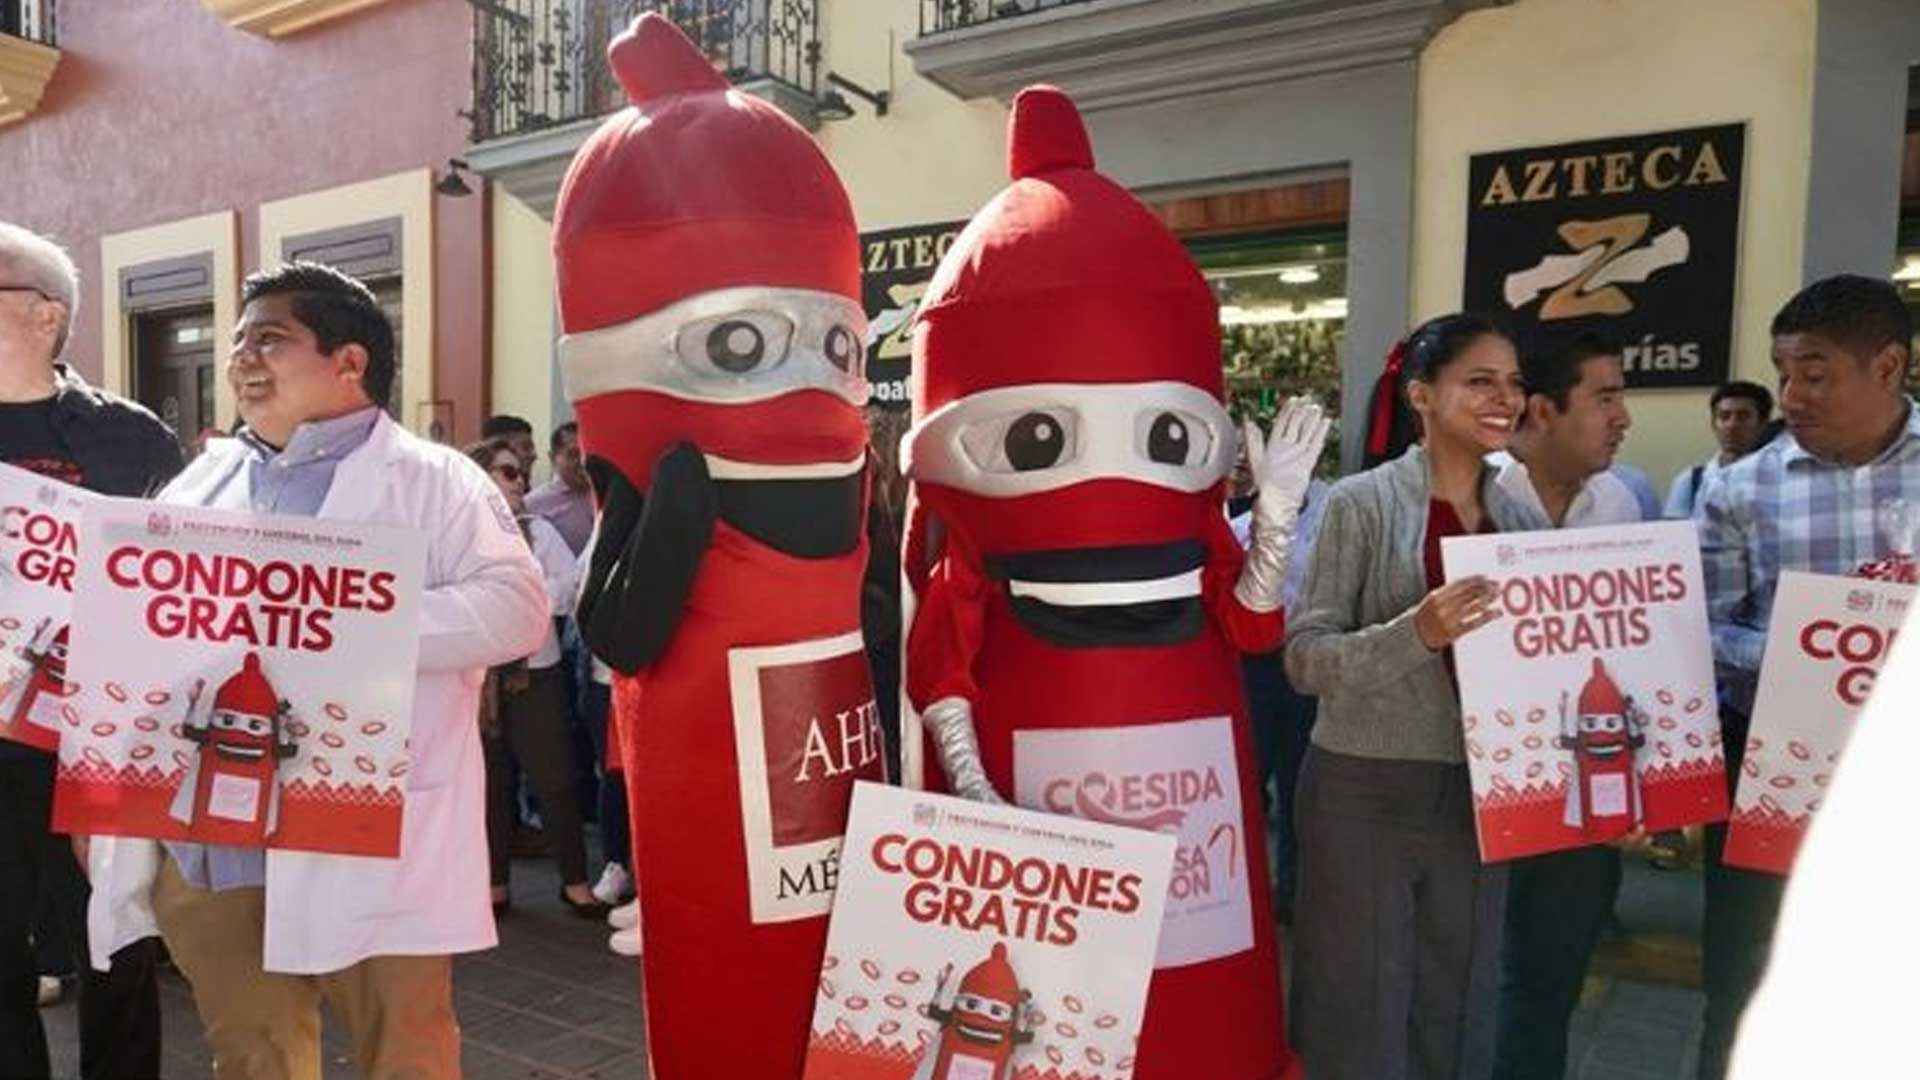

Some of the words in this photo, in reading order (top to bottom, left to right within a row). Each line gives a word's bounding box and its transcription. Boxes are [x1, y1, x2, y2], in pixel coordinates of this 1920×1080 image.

[1482, 141, 1727, 206] AZTECA
[1623, 333, 1700, 372] rías
[17, 549, 76, 593] GR
[106, 546, 397, 613] CONDONES
[1501, 563, 1687, 616] ONDONES
[146, 594, 333, 653] GRATIS
[1513, 607, 1651, 659] GRATIS
[872, 834, 1142, 913] CONDONES
[904, 881, 1079, 946] GRATIS
